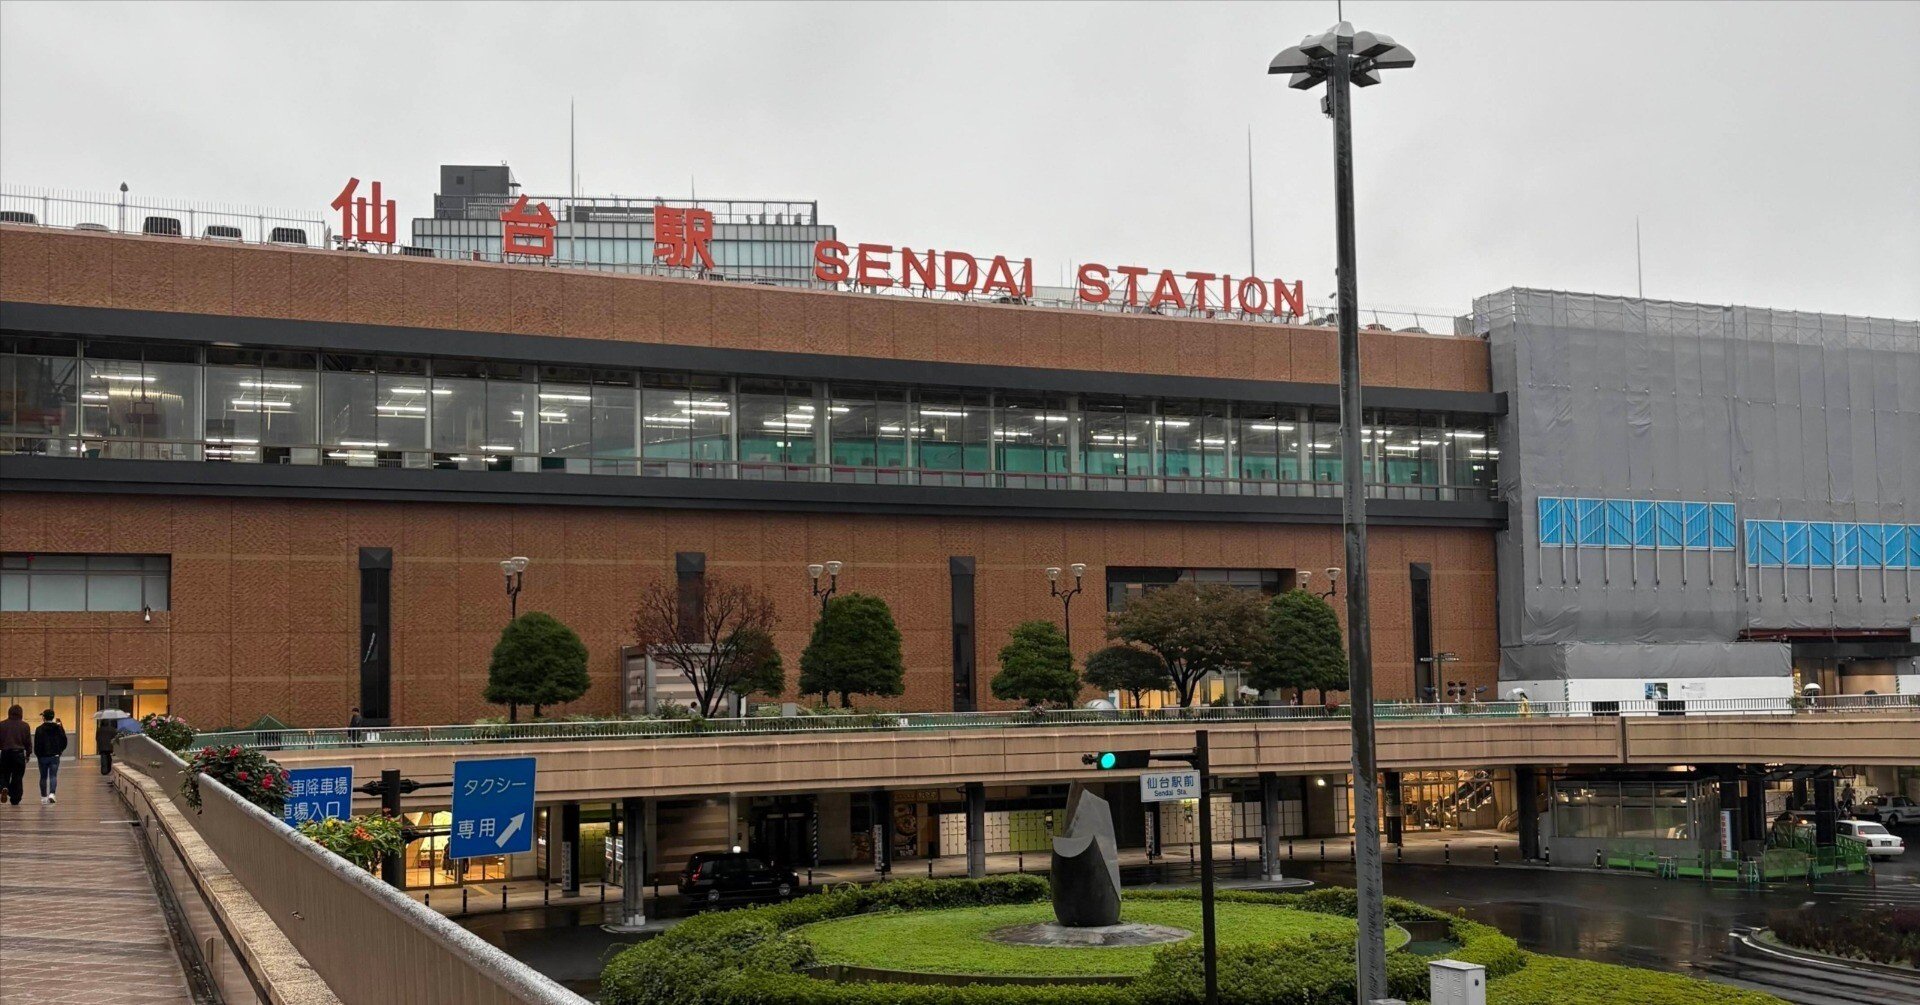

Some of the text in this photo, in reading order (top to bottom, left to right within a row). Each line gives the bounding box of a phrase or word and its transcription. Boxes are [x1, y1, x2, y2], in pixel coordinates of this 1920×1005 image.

[331, 177, 714, 270] 仙台駅
[814, 240, 1304, 318] SENDAI STATION
[463, 777, 527, 796] タクシー
[1147, 776, 1194, 789] 仙台駅前
[1154, 789, 1173, 797] Sendai
[457, 818, 496, 840] 専用
